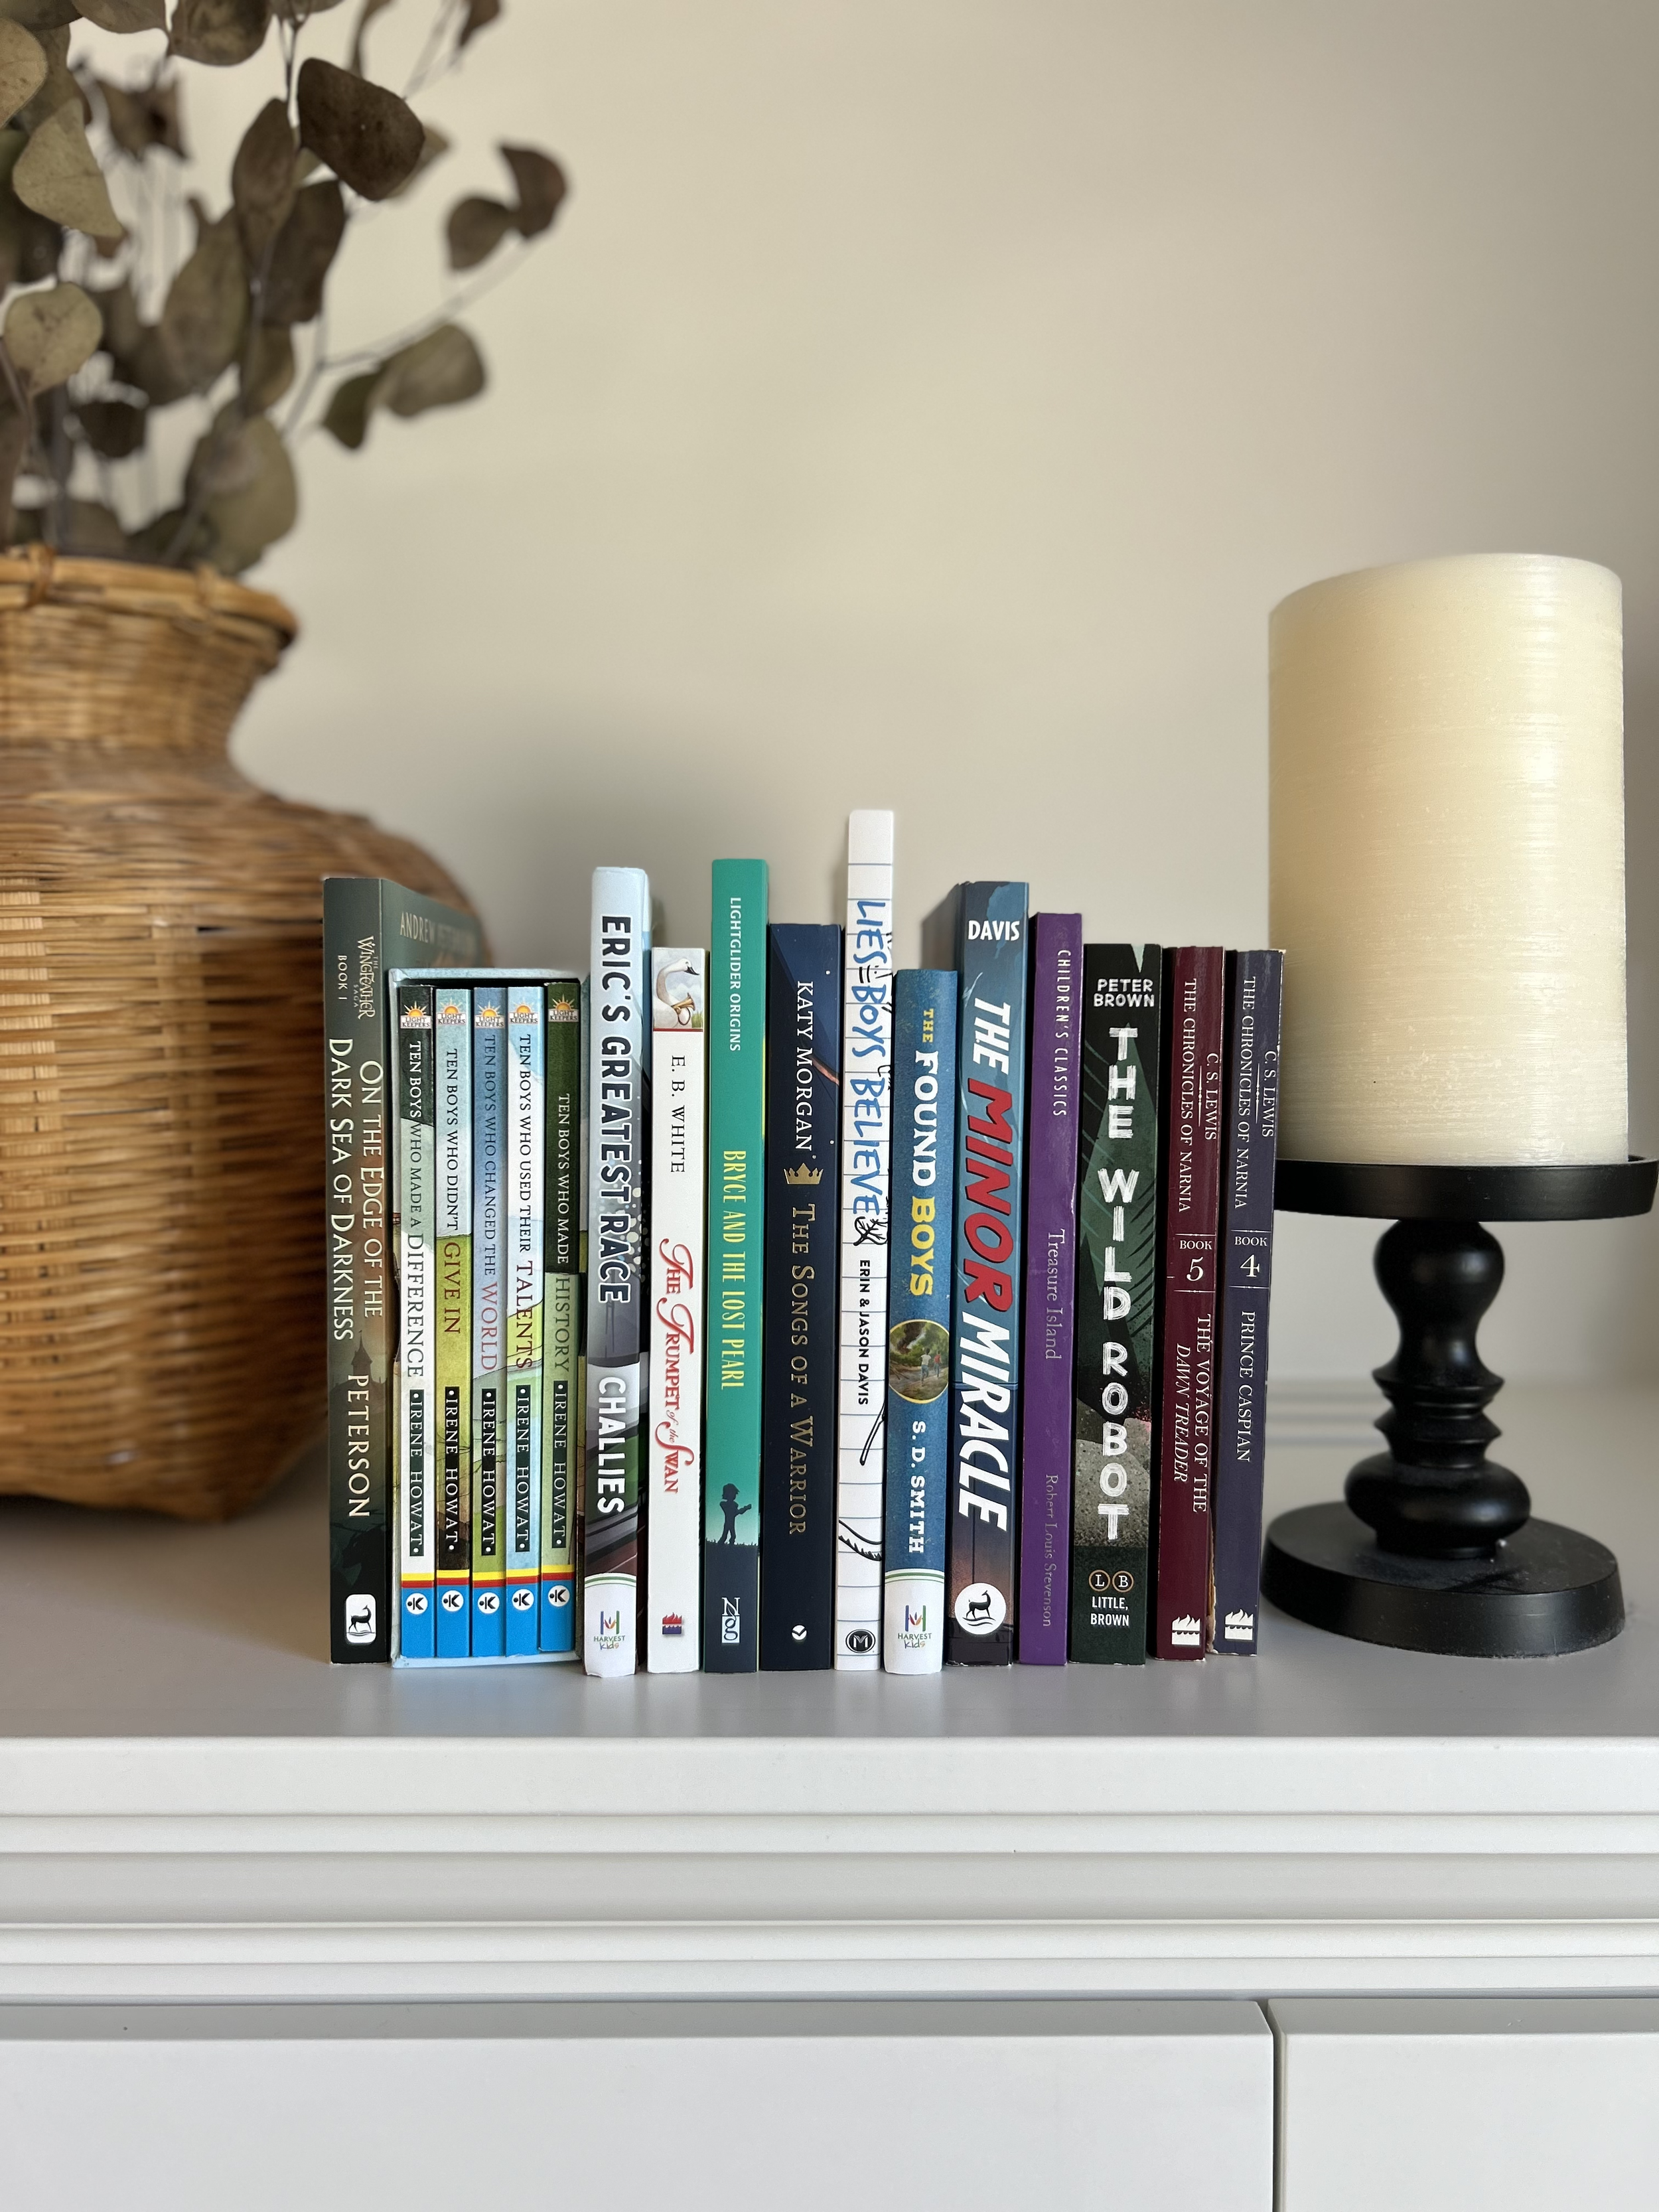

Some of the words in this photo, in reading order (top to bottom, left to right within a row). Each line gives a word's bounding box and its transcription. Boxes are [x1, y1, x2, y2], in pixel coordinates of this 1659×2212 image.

[730, 897, 741, 990] LIGHTGLIDER
[852, 900, 888, 966] LIES
[968, 920, 1020, 942] DAVIS
[338, 955, 348, 990] BOOK
[358, 936, 376, 1019] WINGFEATHER
[602, 915, 631, 1022] ERIC'S
[1097, 979, 1153, 992] PETER
[796, 981, 813, 1040] KATY
[1056, 950, 1071, 1039] CHILDREN'S
[1094, 994, 1154, 1007] BROWN
[1185, 978, 1196, 1013] THE
[1243, 976, 1256, 1010] THE
[730, 993, 741, 1052] ORIGINS
[851, 984, 886, 1059] BOYS
[922, 1009, 934, 1043] THE
[972, 997, 1011, 1075] THE
[330, 1039, 354, 1109] DARK
[409, 1041, 421, 1073] TEN
[447, 1049, 458, 1078] TEN
[485, 1035, 496, 1071] TEN
[520, 1035, 530, 1067] TEN
[671, 1055, 685, 1072] E.
[1182, 1017, 1196, 1120] CHRONICLES
[1206, 1053, 1218, 1067] C.
[1239, 1014, 1254, 1116] CHRONICLES
[1265, 1051, 1276, 1065] C.
[360, 1060, 384, 1104] ON
[409, 1076, 421, 1118] BOYS
[485, 1071, 496, 1112] BOYS
[520, 1072, 531, 1112] BOYS
[671, 1080, 685, 1097] B.
[795, 1047, 812, 1151] MORGAN
[1052, 1047, 1068, 1117] CLASSICS
[1108, 1027, 1138, 1139] THE
[1206, 1071, 1218, 1084] S.
[1264, 1069, 1275, 1082] S.
[447, 1084, 458, 1125] BOYS
[559, 1094, 569, 1125] TEN
[601, 1037, 632, 1203] GREATEST
[912, 1051, 939, 1187] FOUND
[1204, 1089, 1218, 1141] LEWIS
[1262, 1088, 1275, 1138] LEWIS
[330, 1117, 354, 1165] SEA
[363, 1118, 381, 1157] THE
[410, 1124, 421, 1165] WHO
[447, 1131, 458, 1173] WHO
[485, 1116, 496, 1157] WHO
[520, 1117, 531, 1157] WHO
[559, 1129, 569, 1168] BOYS
[670, 1106, 685, 1173] WHITE
[849, 1078, 885, 1215] BELIEVE
[1180, 1124, 1192, 1145] OF
[1237, 1121, 1250, 1142] OF
[334, 1174, 352, 1205] OF
[361, 1166, 382, 1229] EDGE
[410, 1170, 421, 1212] MADE
[485, 1161, 496, 1239] CHANGED
[520, 1161, 531, 1202] USED
[559, 1173, 569, 1213] WHO
[723, 1150, 746, 1203] BRYCE
[964, 1078, 1014, 1313] MINOR
[1179, 1152, 1192, 1213] NARNIA
[1234, 1149, 1249, 1209] NARNIA
[410, 1217, 420, 1228] A
[447, 1177, 459, 1230] DIDN'T
[723, 1209, 745, 1243] AND
[520, 1206, 531, 1253] THEIR
[557, 1219, 569, 1264] MADE
[792, 1204, 816, 1254] THE
[910, 1197, 936, 1295] BOYS
[1097, 1168, 1139, 1321] WILD
[1179, 1240, 1212, 1250] BOOK
[1234, 1236, 1267, 1246] BOOK
[363, 1238, 383, 1269] OF
[443, 1242, 461, 1301] GIVE
[484, 1243, 496, 1276] THE
[599, 1216, 632, 1304] RACE
[659, 1238, 693, 1294] THE
[723, 1251, 745, 1282] THE
[860, 1260, 870, 1292] ERIN
[1046, 1228, 1064, 1302] Treasure
[1187, 1258, 1203, 1282] 5
[1241, 1255, 1260, 1278] 4
[330, 1215, 355, 1340] DARKNESS
[364, 1276, 384, 1317] THE
[407, 1234, 424, 1377] DIFFERENCE
[445, 1307, 460, 1334] IN
[482, 1282, 498, 1371] WORLD
[516, 1260, 533, 1368] TALENTS
[556, 1278, 570, 1372] HISTORY
[723, 1290, 745, 1331] LOST
[791, 1264, 815, 1347] SONGS
[860, 1299, 870, 1307] &
[656, 1297, 694, 1410] TRUMPET
[859, 1311, 870, 1358] JASON
[1046, 1307, 1061, 1360] Island
[1196, 1314, 1212, 1353] THE
[1240, 1311, 1256, 1378] PRINCE
[722, 1333, 745, 1390] PEARL
[791, 1356, 808, 1386] OF
[858, 1363, 869, 1405] DAVIS
[1175, 1343, 1192, 1396] DAWN
[554, 1393, 567, 1448] IRENE
[666, 1410, 680, 1425] of
[791, 1393, 807, 1408] A
[958, 1311, 1011, 1532] MIRACLE
[1194, 1359, 1210, 1438] VOYAGE
[347, 1375, 370, 1517] PETERSON
[410, 1402, 422, 1457] IRENE
[447, 1400, 458, 1455] IRENE
[483, 1401, 495, 1456] IRENE
[517, 1398, 529, 1453] IRENE
[597, 1376, 626, 1514] CHALLIES
[669, 1427, 679, 1443] the
[912, 1421, 926, 1440] S.
[1097, 1342, 1129, 1540] ROBOT
[1173, 1402, 1190, 1482] TREADER
[1238, 1385, 1252, 1462] CASPIAN
[654, 1422, 695, 1493] SWAN
[789, 1416, 815, 1534] WARRIOR
[911, 1447, 925, 1467] D.
[1194, 1446, 1209, 1467] OF
[410, 1471, 422, 1544] HOWAT
[447, 1469, 458, 1541] HOWAT
[483, 1469, 495, 1545] HOWAT
[517, 1467, 529, 1541] HOWAT
[553, 1463, 566, 1537] HOWAT
[909, 1477, 925, 1553] SMITH
[1045, 1473, 1058, 1518] Robert
[1192, 1473, 1208, 1513] THE
[1045, 1524, 1057, 1558] Louis
[1043, 1562, 1056, 1627] Stevenson
[1091, 1596, 1129, 1611] LITTLE,
[1094, 1574, 1105, 1587] L
[1118, 1574, 1129, 1588] B
[1090, 1613, 1129, 1626] BROWN
[600, 1641, 619, 1650] kids
[904, 1639, 925, 1649] kids
